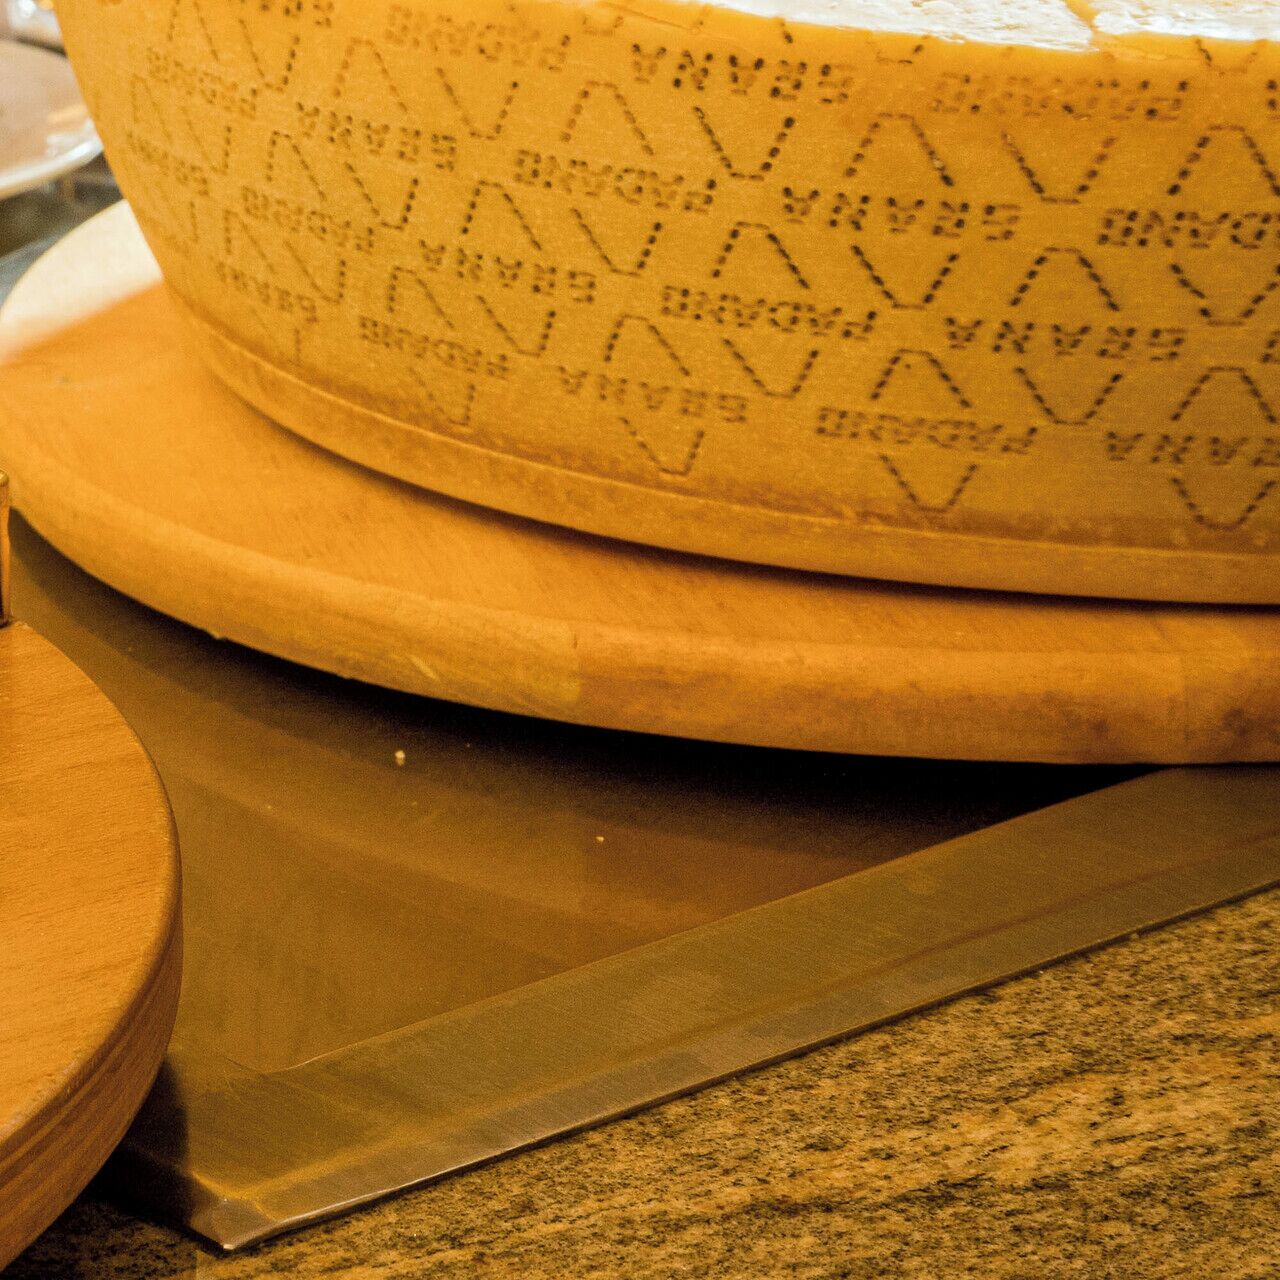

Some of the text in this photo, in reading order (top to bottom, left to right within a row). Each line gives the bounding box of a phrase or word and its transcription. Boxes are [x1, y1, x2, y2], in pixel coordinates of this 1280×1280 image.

[632, 42, 856, 105] GRANA
[295, 100, 458, 172] GRANA
[782, 184, 1022, 243] GRANA
[1096, 205, 1280, 249] DANO
[419, 237, 596, 304] GRANA
[660, 284, 878, 342] PADANO
[945, 315, 1187, 363] GRANA
[556, 364, 747, 422] GRANA
[817, 406, 1039, 456] PADANO
[1105, 430, 1280, 468] RANA
